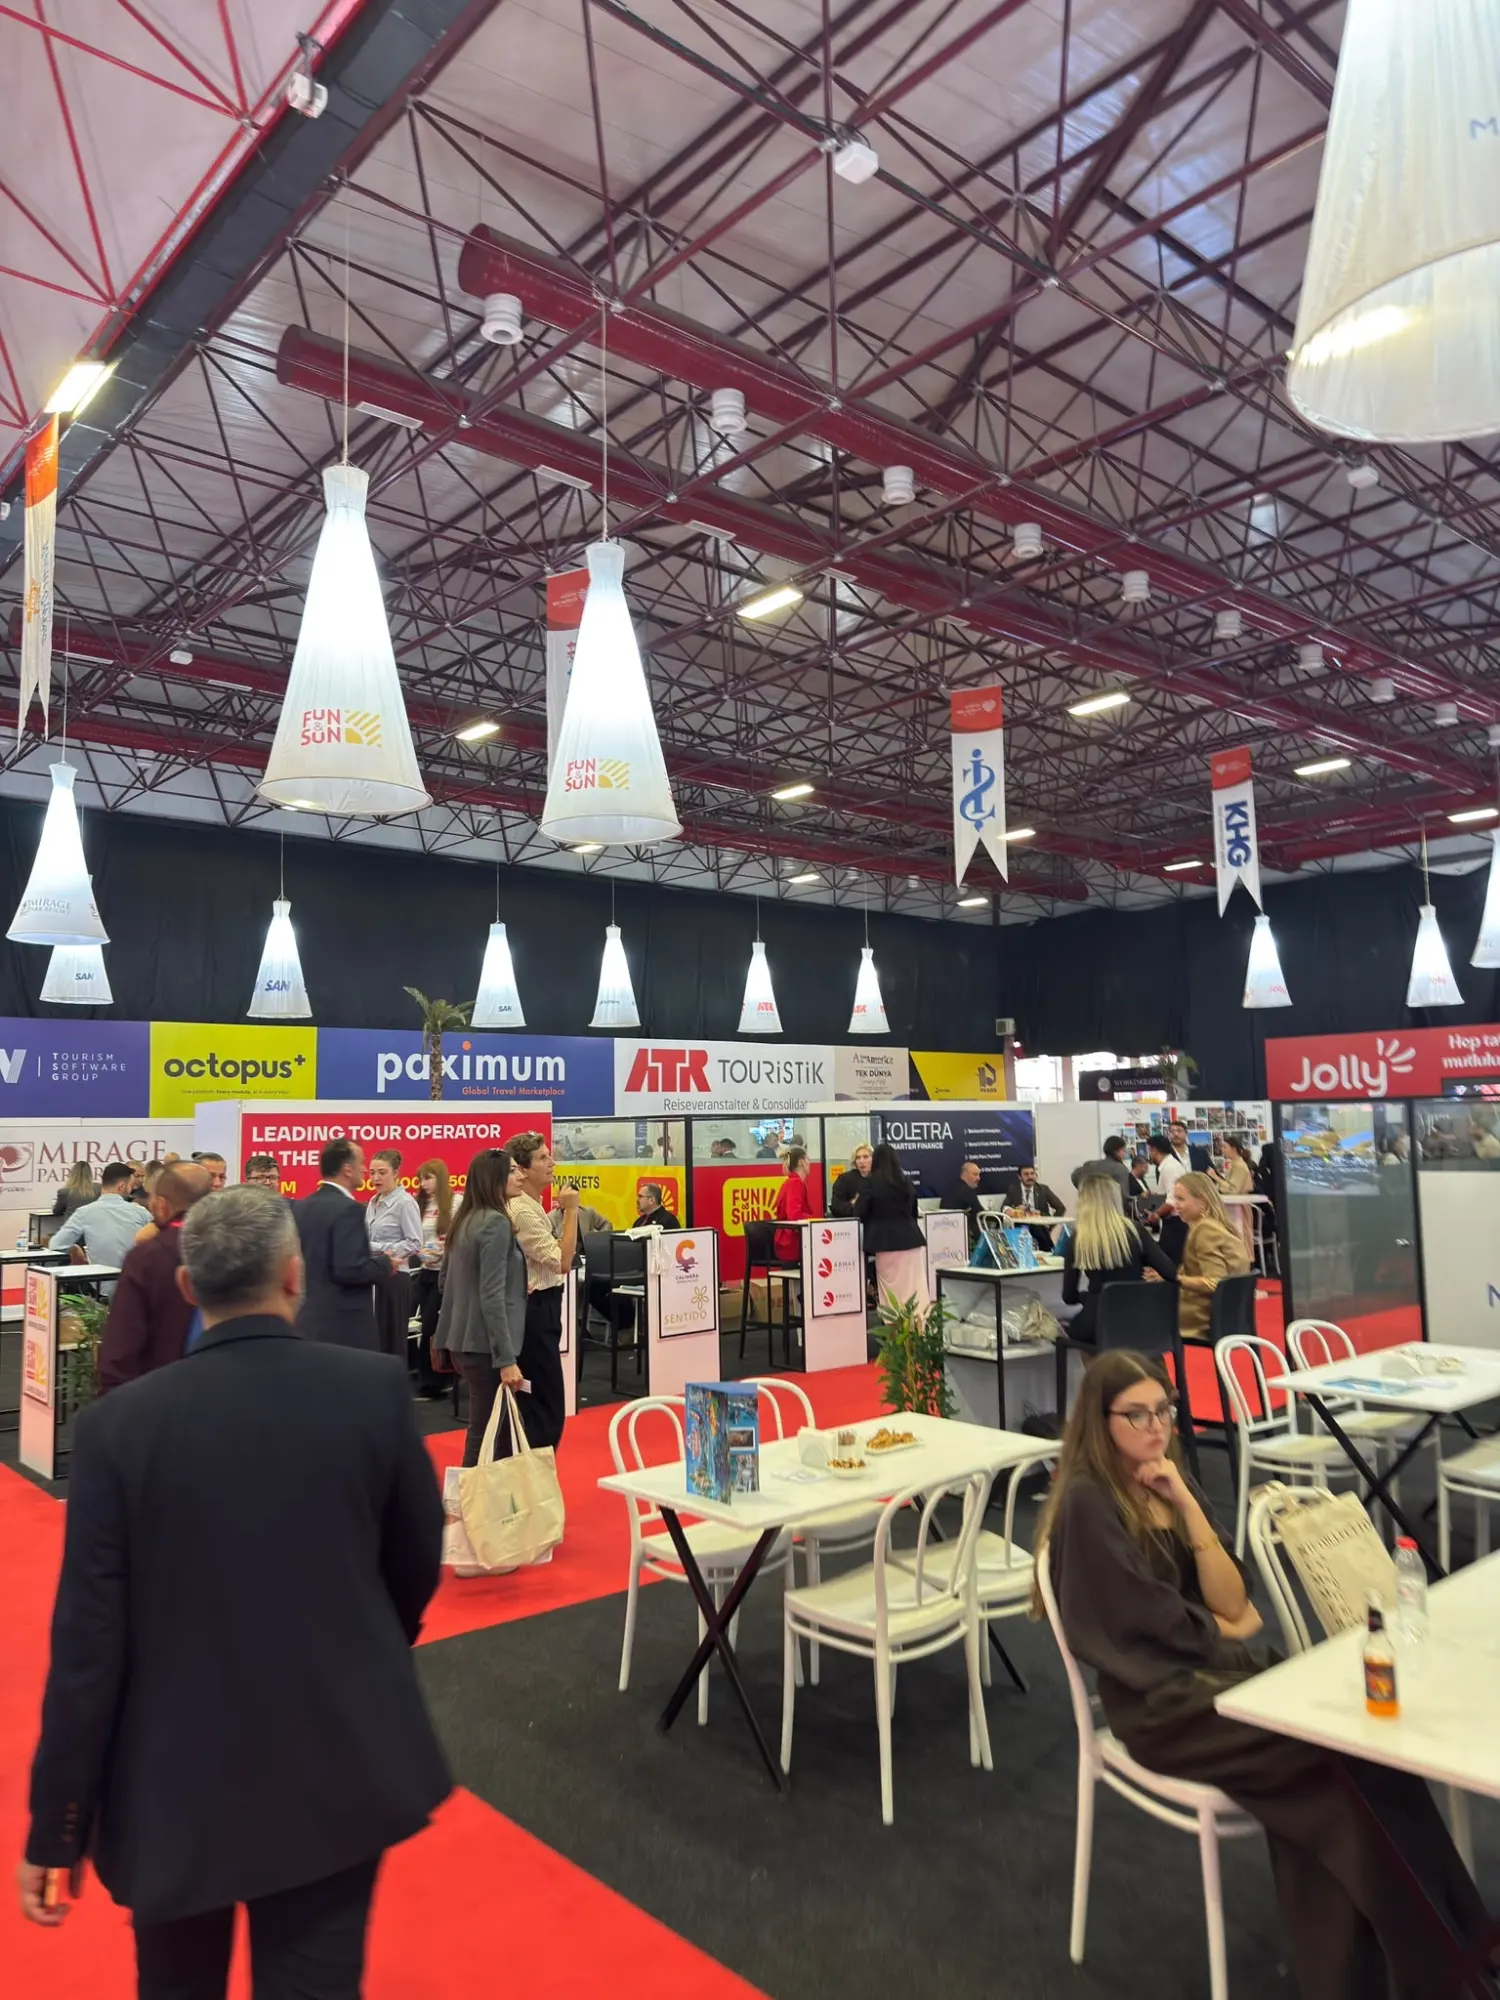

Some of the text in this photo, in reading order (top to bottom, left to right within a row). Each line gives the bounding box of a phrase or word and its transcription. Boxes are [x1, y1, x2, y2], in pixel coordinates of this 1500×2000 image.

[303, 708, 341, 728] FUN
[301, 726, 341, 746] SUN
[567, 758, 596, 777] FUN
[564, 773, 596, 792] SUN
[1224, 800, 1252, 867] KHG
[75, 973, 95, 981] SAN
[264, 979, 291, 992] SAN
[756, 1001, 775, 1012] ATR
[1448, 1032, 1481, 1052] Hop
[52, 1053, 115, 1061] TOURISM
[52, 1063, 127, 1072] SOFTWARE
[377, 1040, 566, 1093] paximum
[624, 1048, 712, 1093] ATR
[855, 1069, 868, 1077] TEK
[52, 1073, 99, 1081] GROUP
[1290, 1054, 1389, 1098] Jolly
[462, 1086, 566, 1097] Global Travel Marketplace
[664, 1098, 750, 1111] Reiseveranstalter
[752, 1098, 760, 1110] &
[252, 1124, 501, 1142] LEADING TOUR OPERATOR
[38, 1140, 166, 1165] MIRAGE
[918, 1142, 943, 1150] FINANCE
[278, 1150, 320, 1166] THE
[552, 1175, 600, 1189] MARKETS
[732, 1188, 760, 1206] FUN
[732, 1207, 760, 1225] SUN
[664, 1310, 707, 1325] SENTIDO
